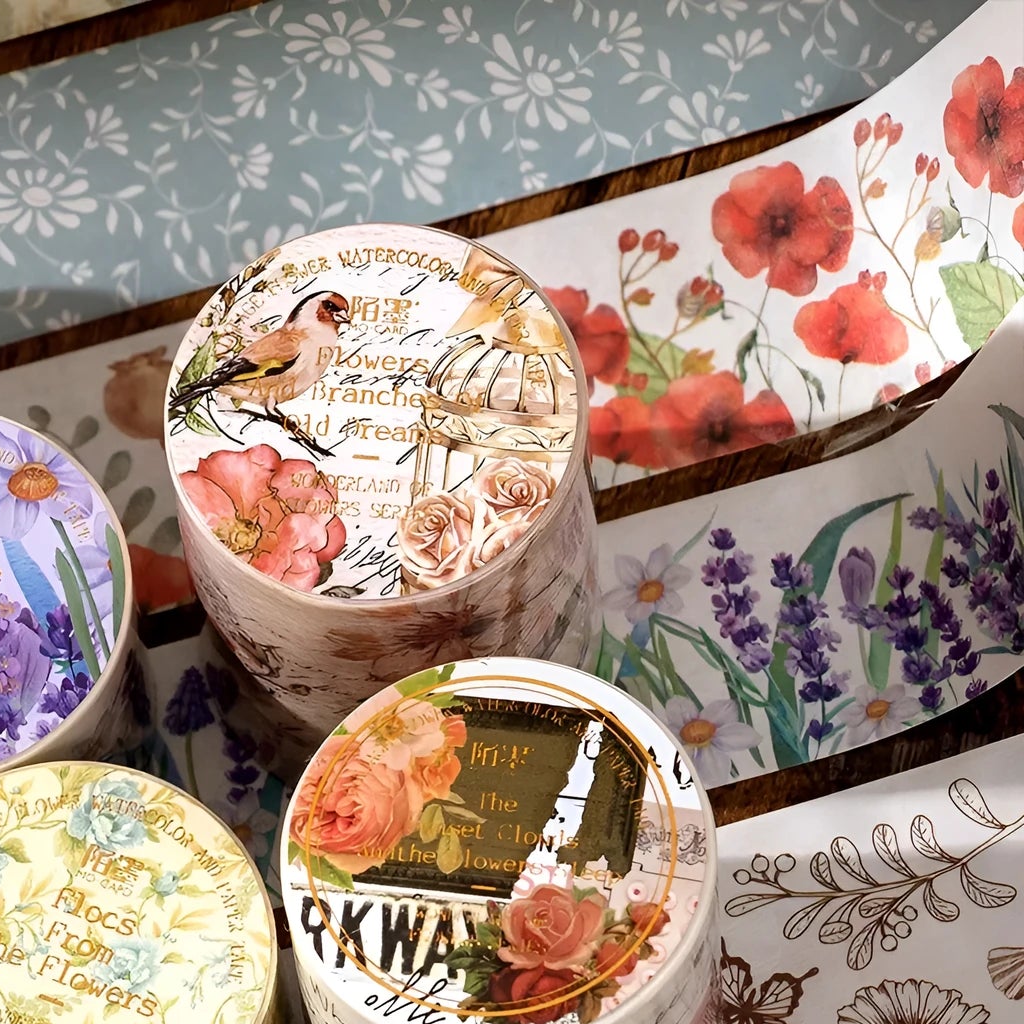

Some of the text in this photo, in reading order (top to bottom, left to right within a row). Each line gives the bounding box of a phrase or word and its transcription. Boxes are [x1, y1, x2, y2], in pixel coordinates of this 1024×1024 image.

[315, 345, 431, 375] Flowers
[311, 380, 441, 411] Branches
[282, 413, 332, 438] Old
[479, 791, 519, 813] The
[50, 886, 138, 937] Flocs
[43, 920, 116, 966] From
[35, 954, 159, 1018] Flowers
